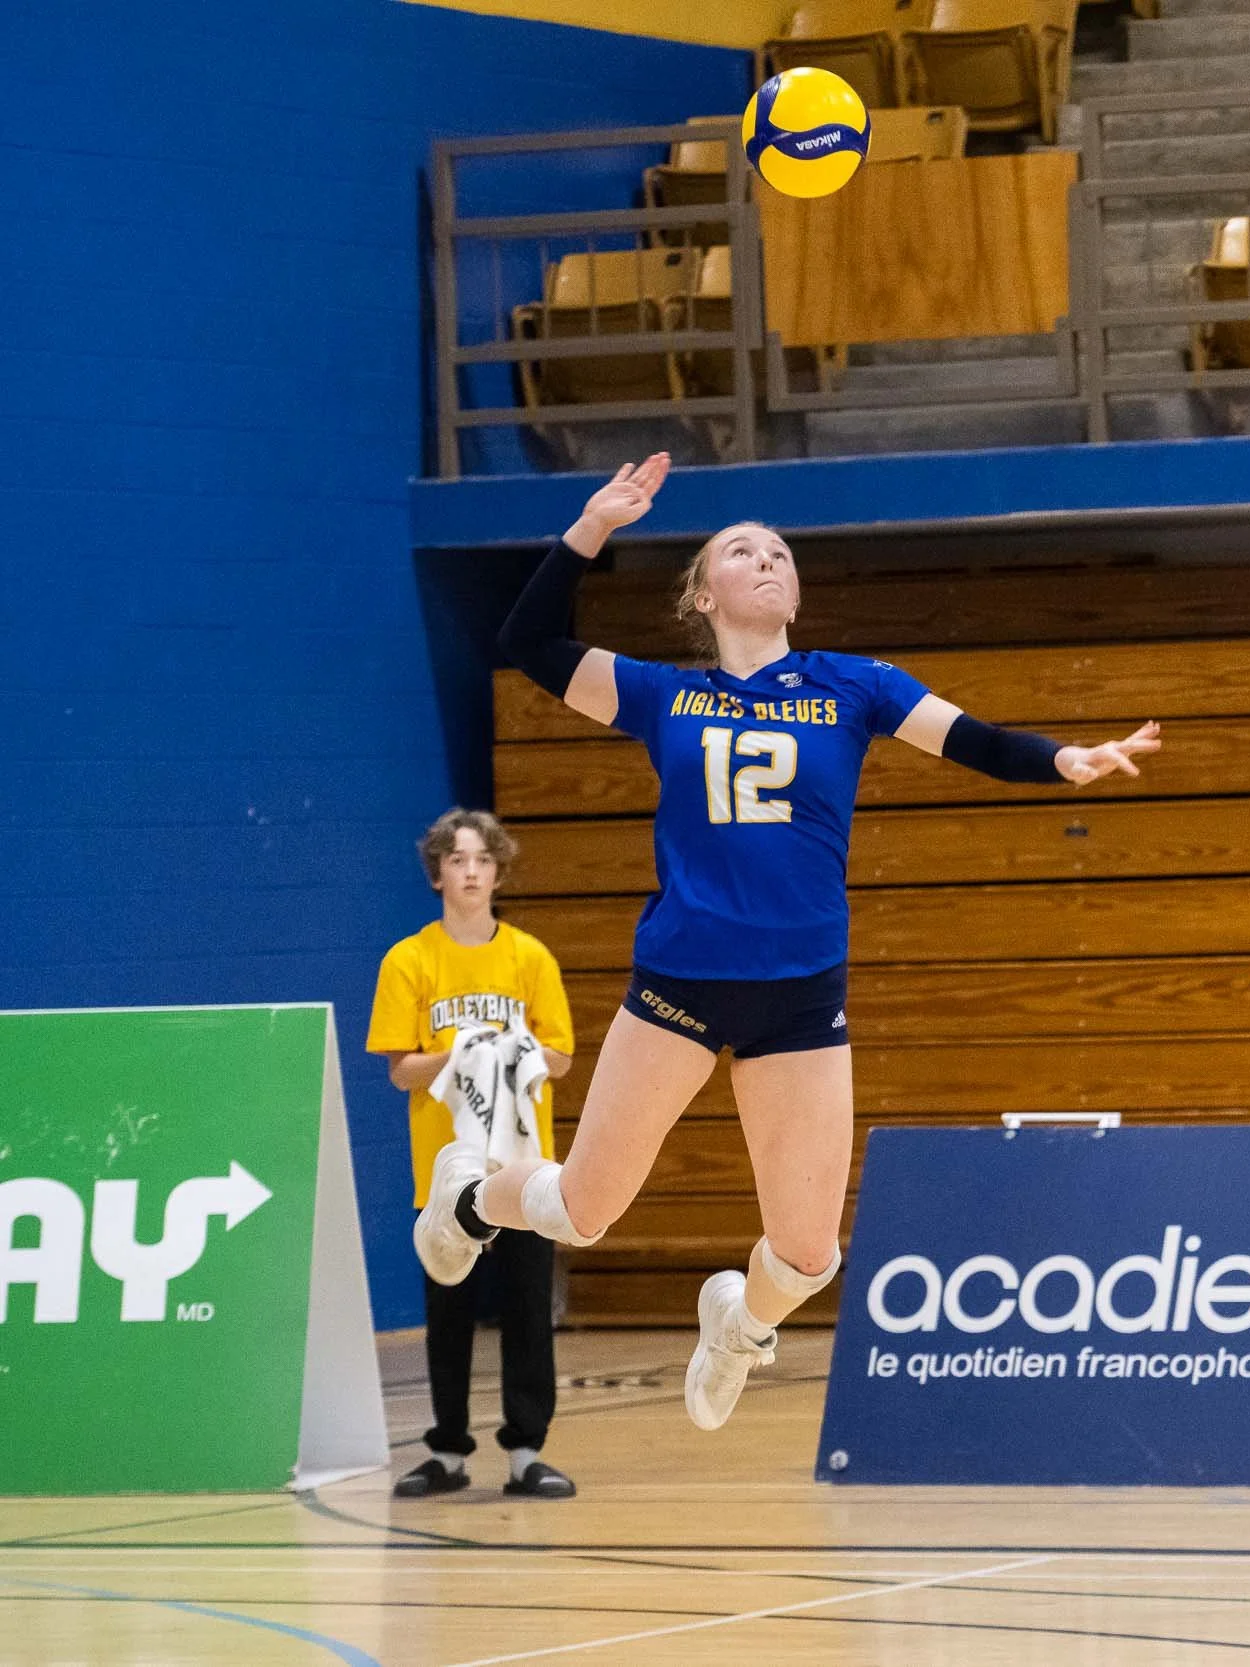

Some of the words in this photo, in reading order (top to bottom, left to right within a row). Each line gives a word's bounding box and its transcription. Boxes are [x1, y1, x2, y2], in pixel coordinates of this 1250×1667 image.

[670, 689, 745, 719] AIGLES
[701, 726, 798, 824] 12
[176, 1302, 215, 1322] MD
[867, 1346, 899, 1378] le
[906, 1346, 1067, 1385] quotidien
